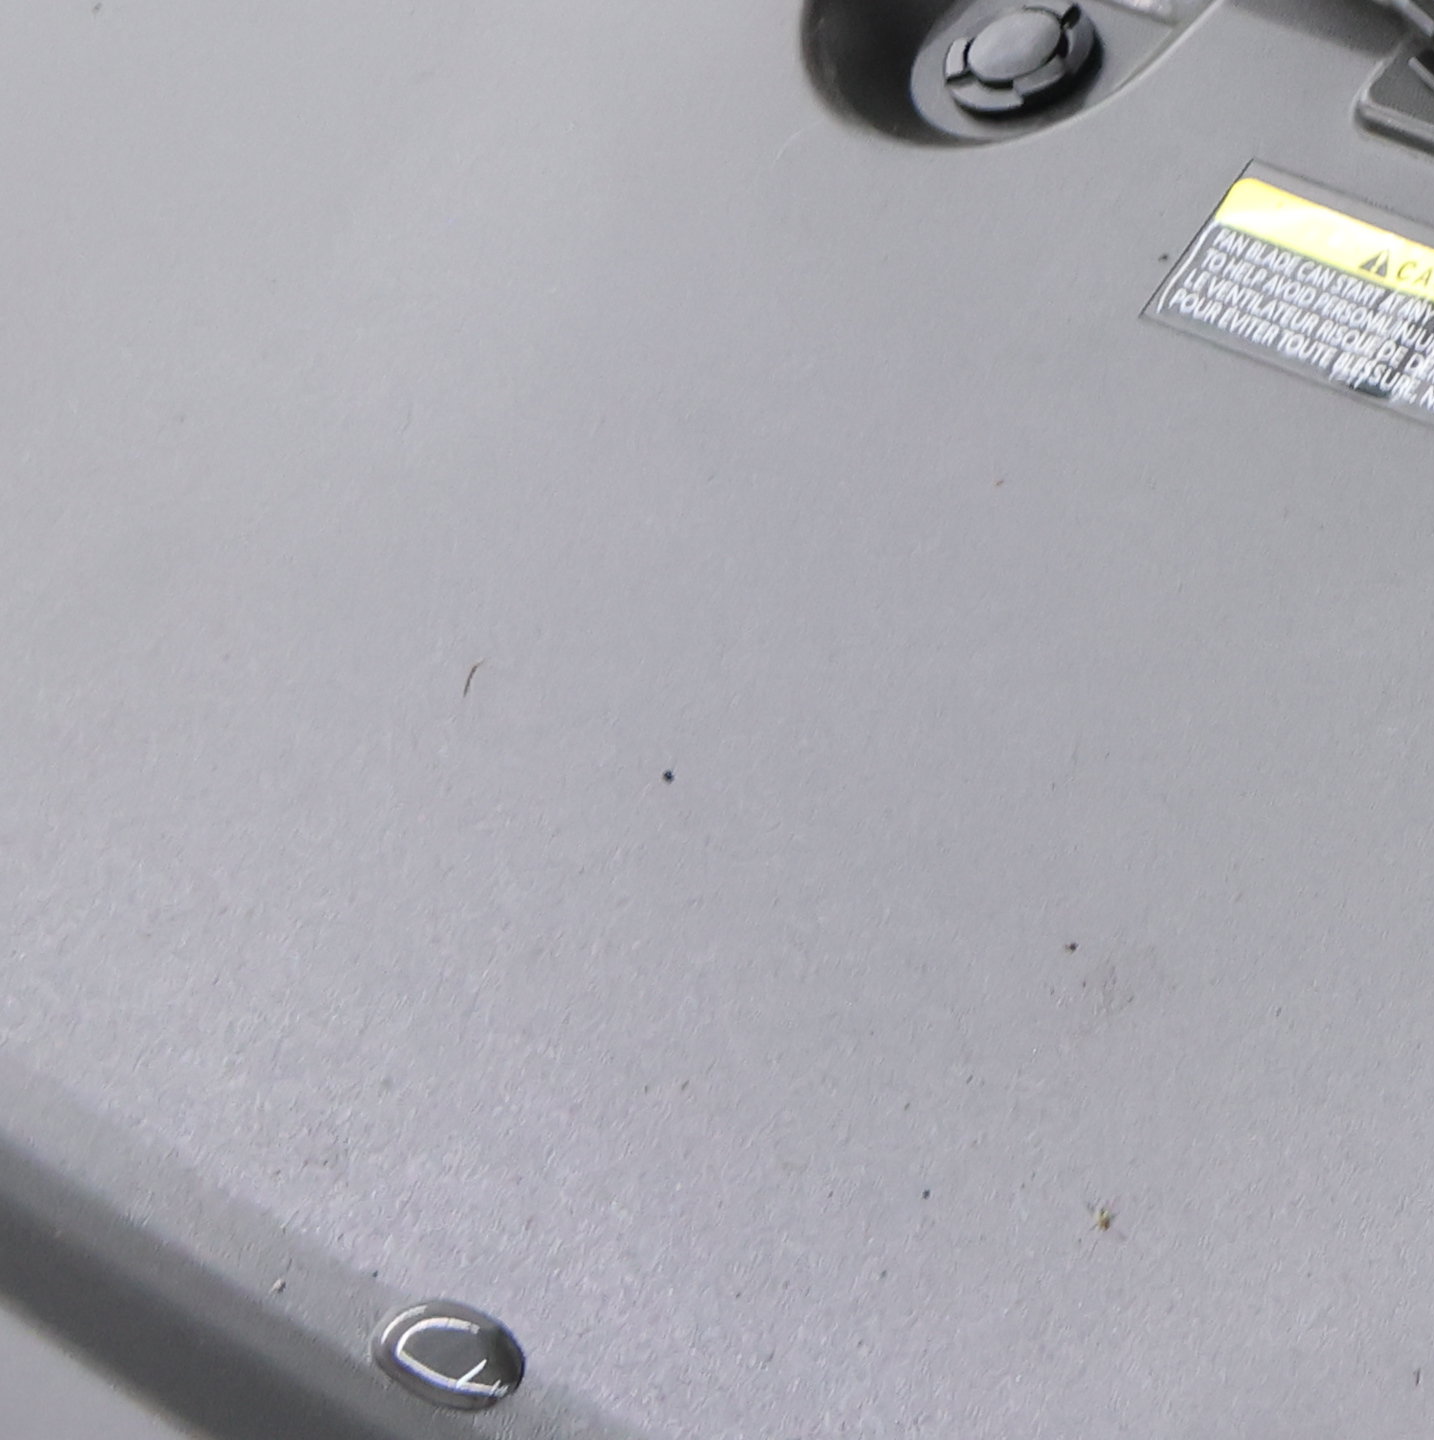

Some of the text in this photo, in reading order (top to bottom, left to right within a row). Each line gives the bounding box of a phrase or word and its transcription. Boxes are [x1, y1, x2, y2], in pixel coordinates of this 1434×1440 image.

[1202, 249, 1224, 270] TO
[1221, 256, 1263, 288] HELP
[1262, 271, 1317, 307] AVOID
[1313, 290, 1397, 338] PERSONAL
[1213, 228, 1252, 257] FAN
[1248, 240, 1301, 274] BLADE
[1298, 260, 1334, 287] CAN
[1331, 273, 1388, 308] START
[1168, 288, 1221, 323] POUR
[1278, 329, 1338, 368] TOUTE
[1184, 269, 1208, 291] LE
[1206, 275, 1321, 334] VENTILATEUR
[1316, 320, 1380, 359] RISQUE
[1376, 338, 1409, 370] DE
